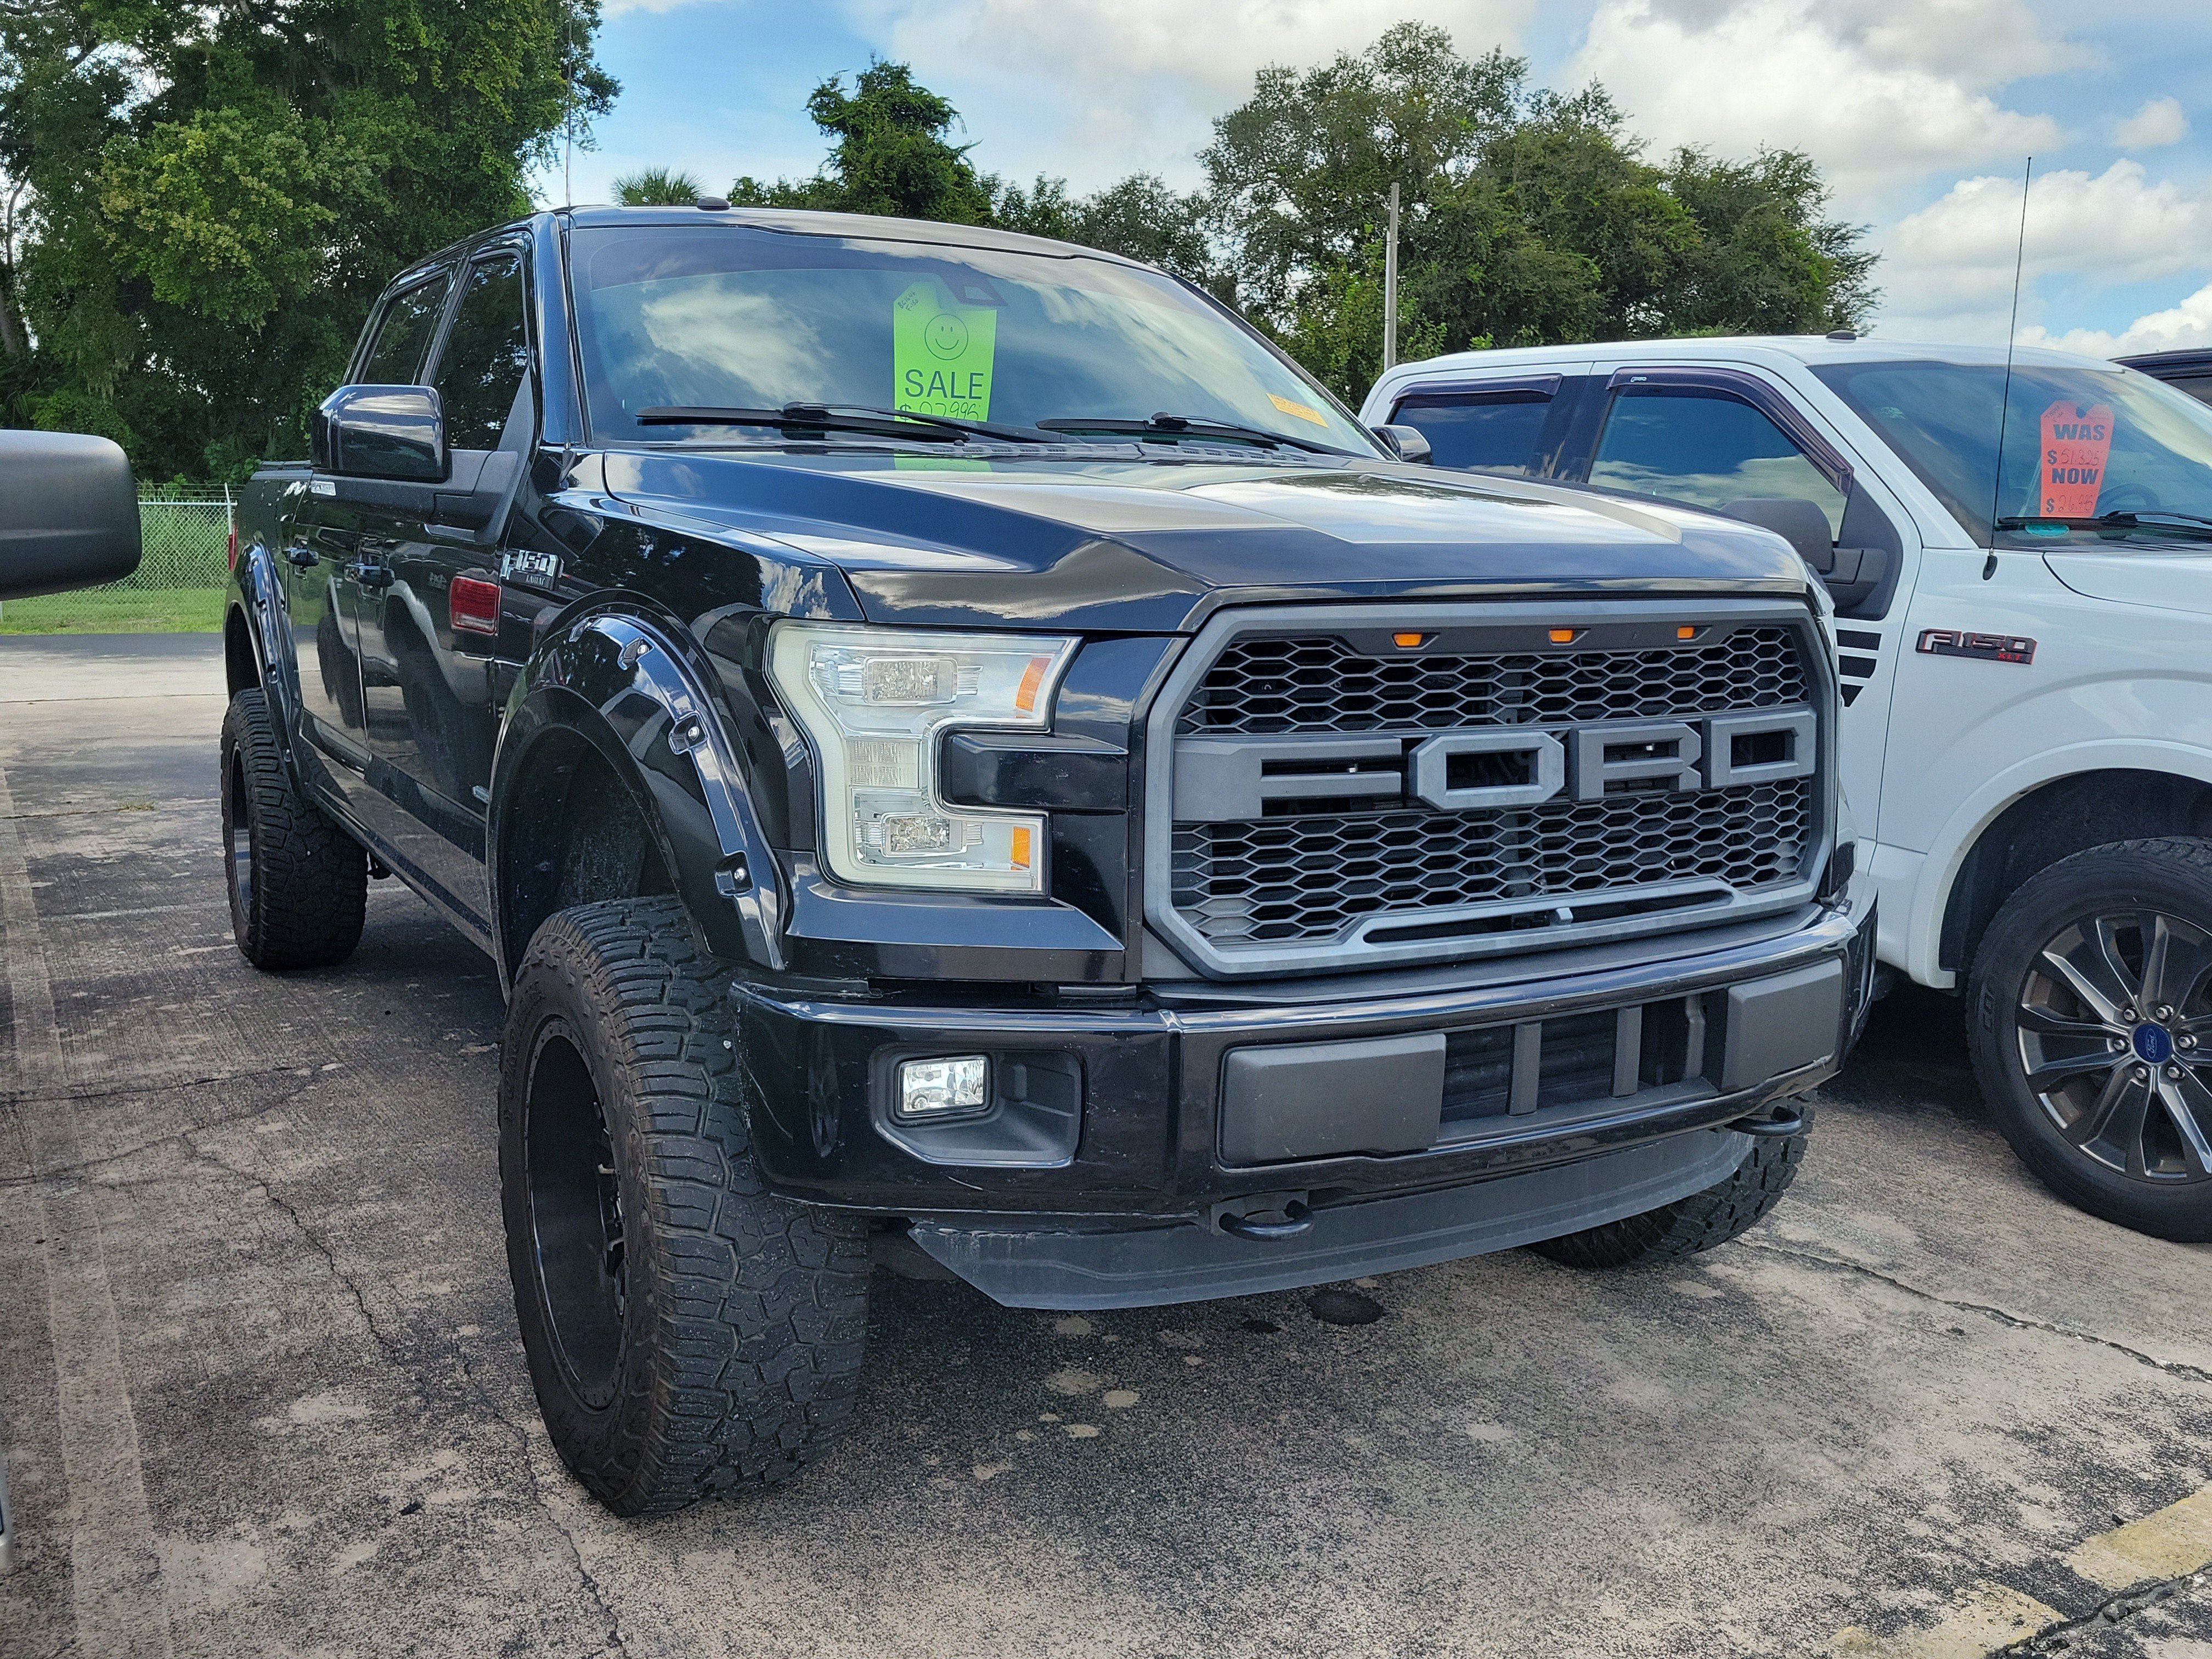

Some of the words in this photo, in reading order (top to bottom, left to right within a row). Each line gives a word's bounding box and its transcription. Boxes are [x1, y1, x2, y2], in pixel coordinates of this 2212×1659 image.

[905, 369, 984, 399] SALE
[2053, 424, 2105, 441] WAS
[2052, 468, 2098, 484] NOW
[1916, 629, 2037, 654] F150
[1998, 652, 2022, 661] XLT
[1173, 706, 1817, 821] FORD
[2147, 1034, 2155, 1053] Ford
